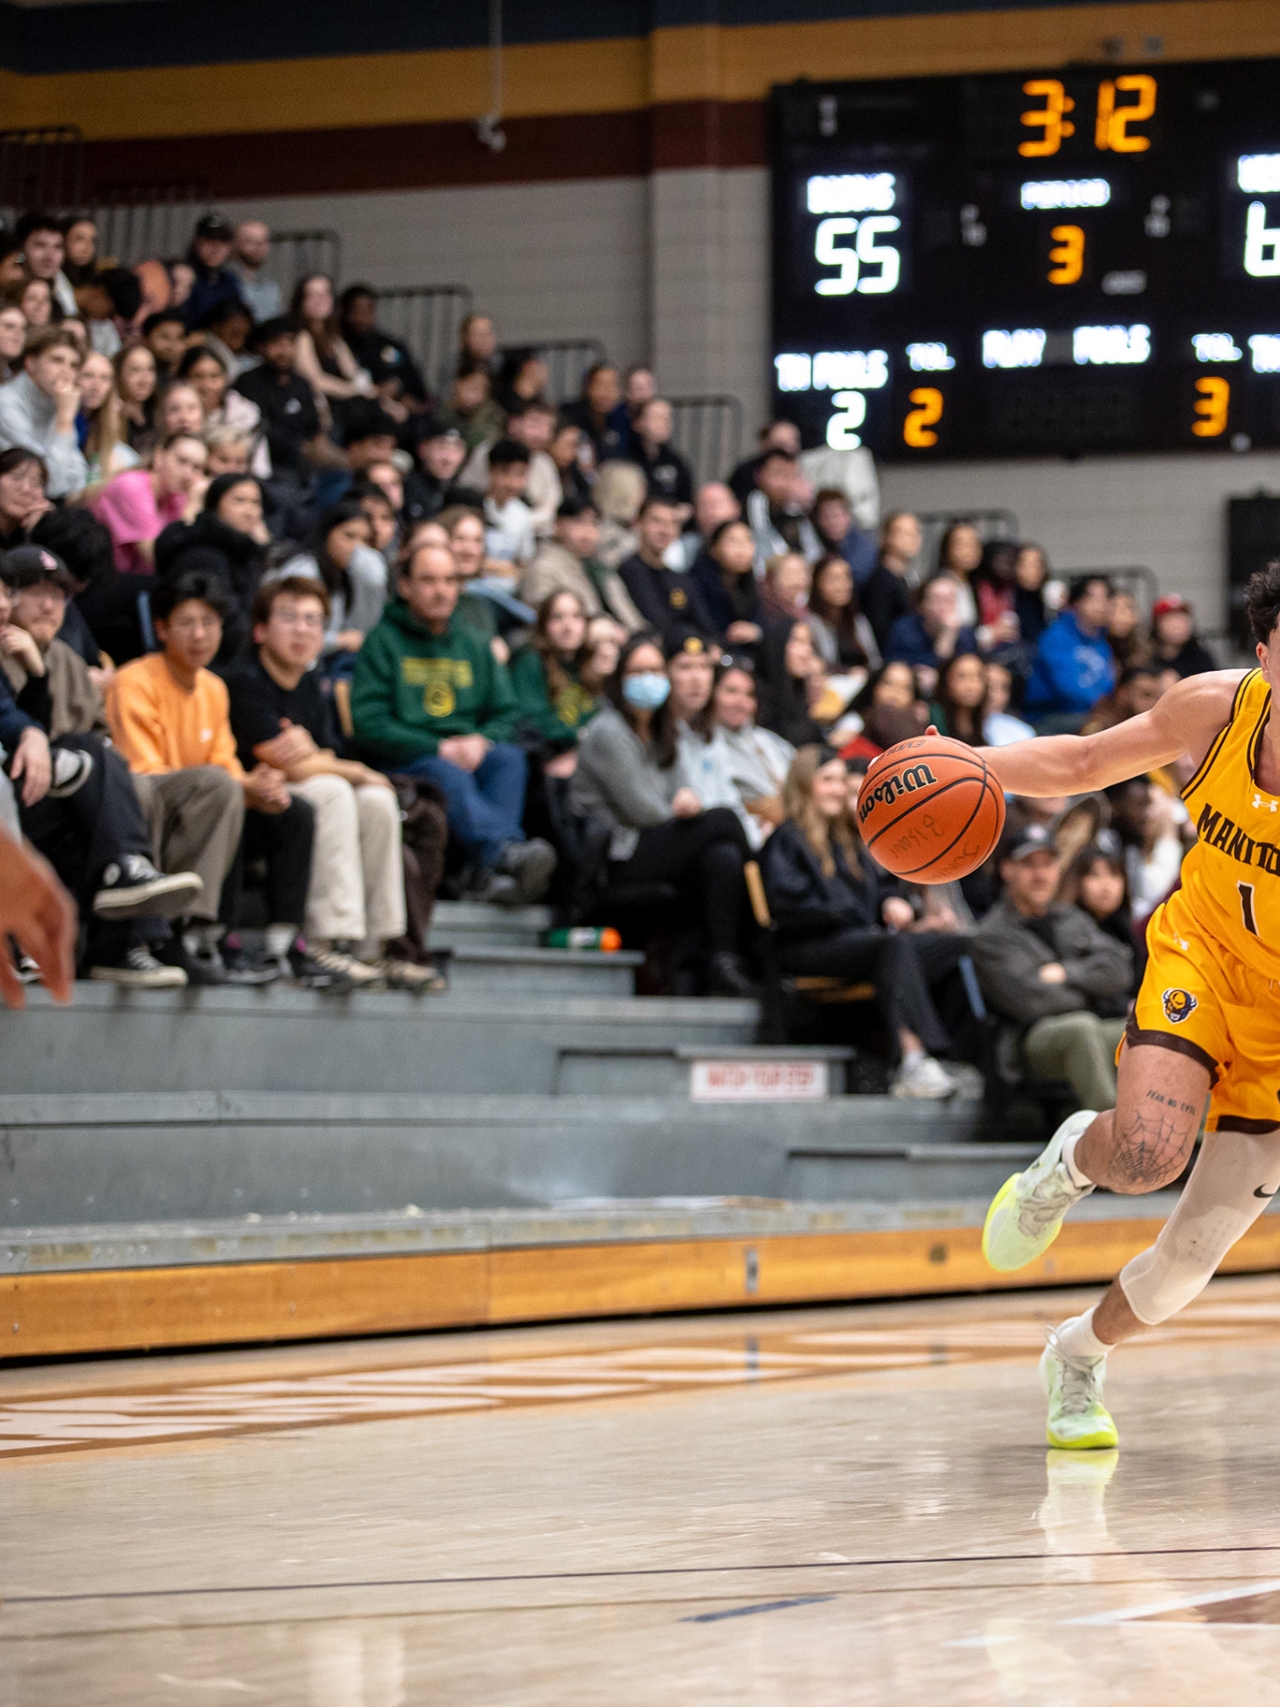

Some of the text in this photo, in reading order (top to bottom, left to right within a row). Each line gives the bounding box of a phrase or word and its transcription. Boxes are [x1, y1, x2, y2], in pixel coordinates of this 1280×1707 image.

[814, 215, 901, 295] 55
[1050, 226, 1084, 284] 3
[826, 390, 866, 451] 2
[903, 387, 944, 448] 2
[1191, 376, 1230, 437] 3
[858, 763, 938, 824] Wilson
[1236, 879, 1261, 938] 1
